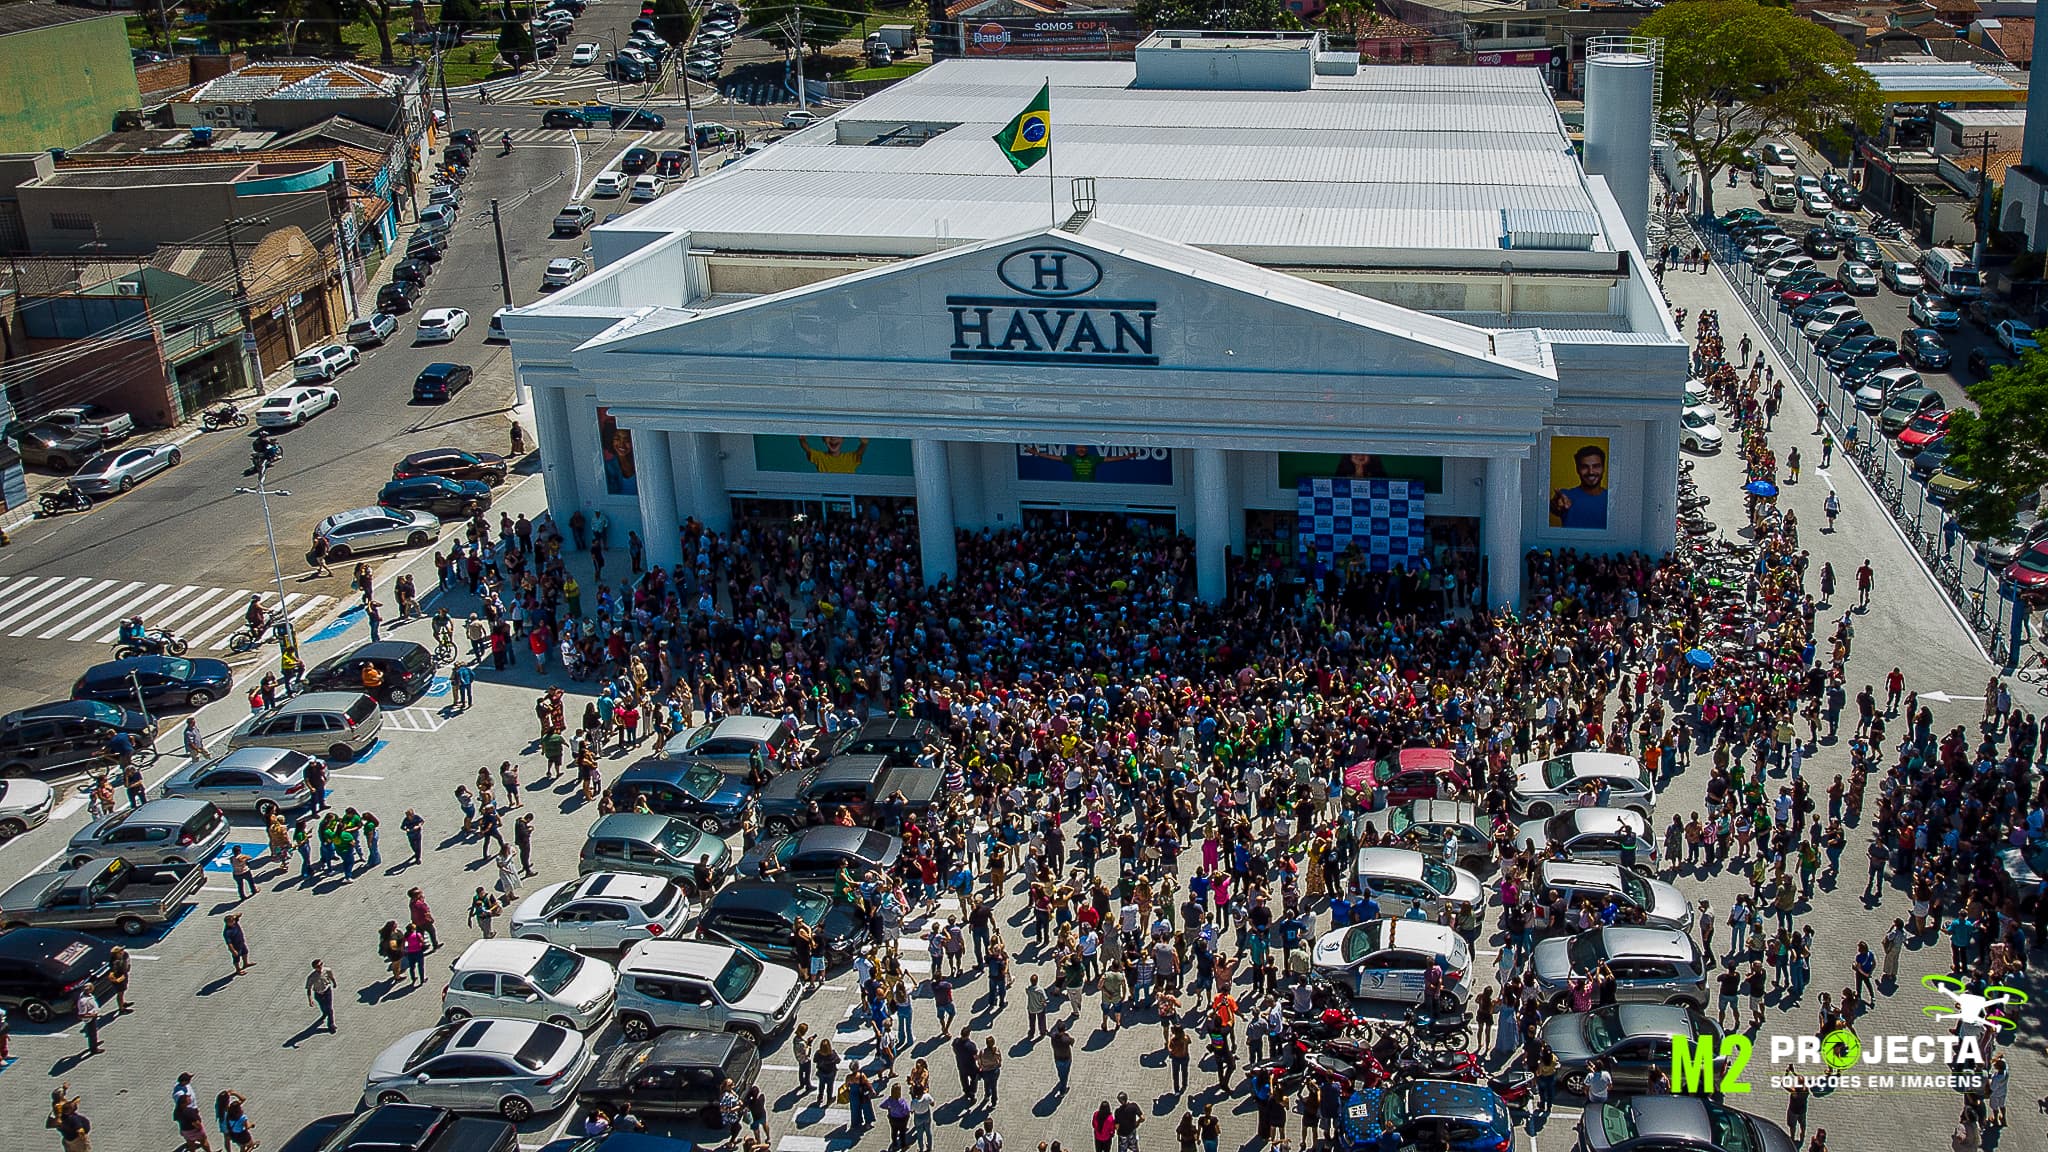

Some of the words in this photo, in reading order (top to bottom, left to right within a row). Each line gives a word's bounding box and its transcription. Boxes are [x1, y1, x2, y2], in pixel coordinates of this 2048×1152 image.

[1034, 22, 1074, 31] SOMOS
[1075, 22, 1096, 30] TOP
[974, 31, 1011, 43] Danelli
[1029, 254, 1068, 290] H
[948, 306, 1156, 354] HAVAN
[1096, 444, 1168, 461] VINDO
